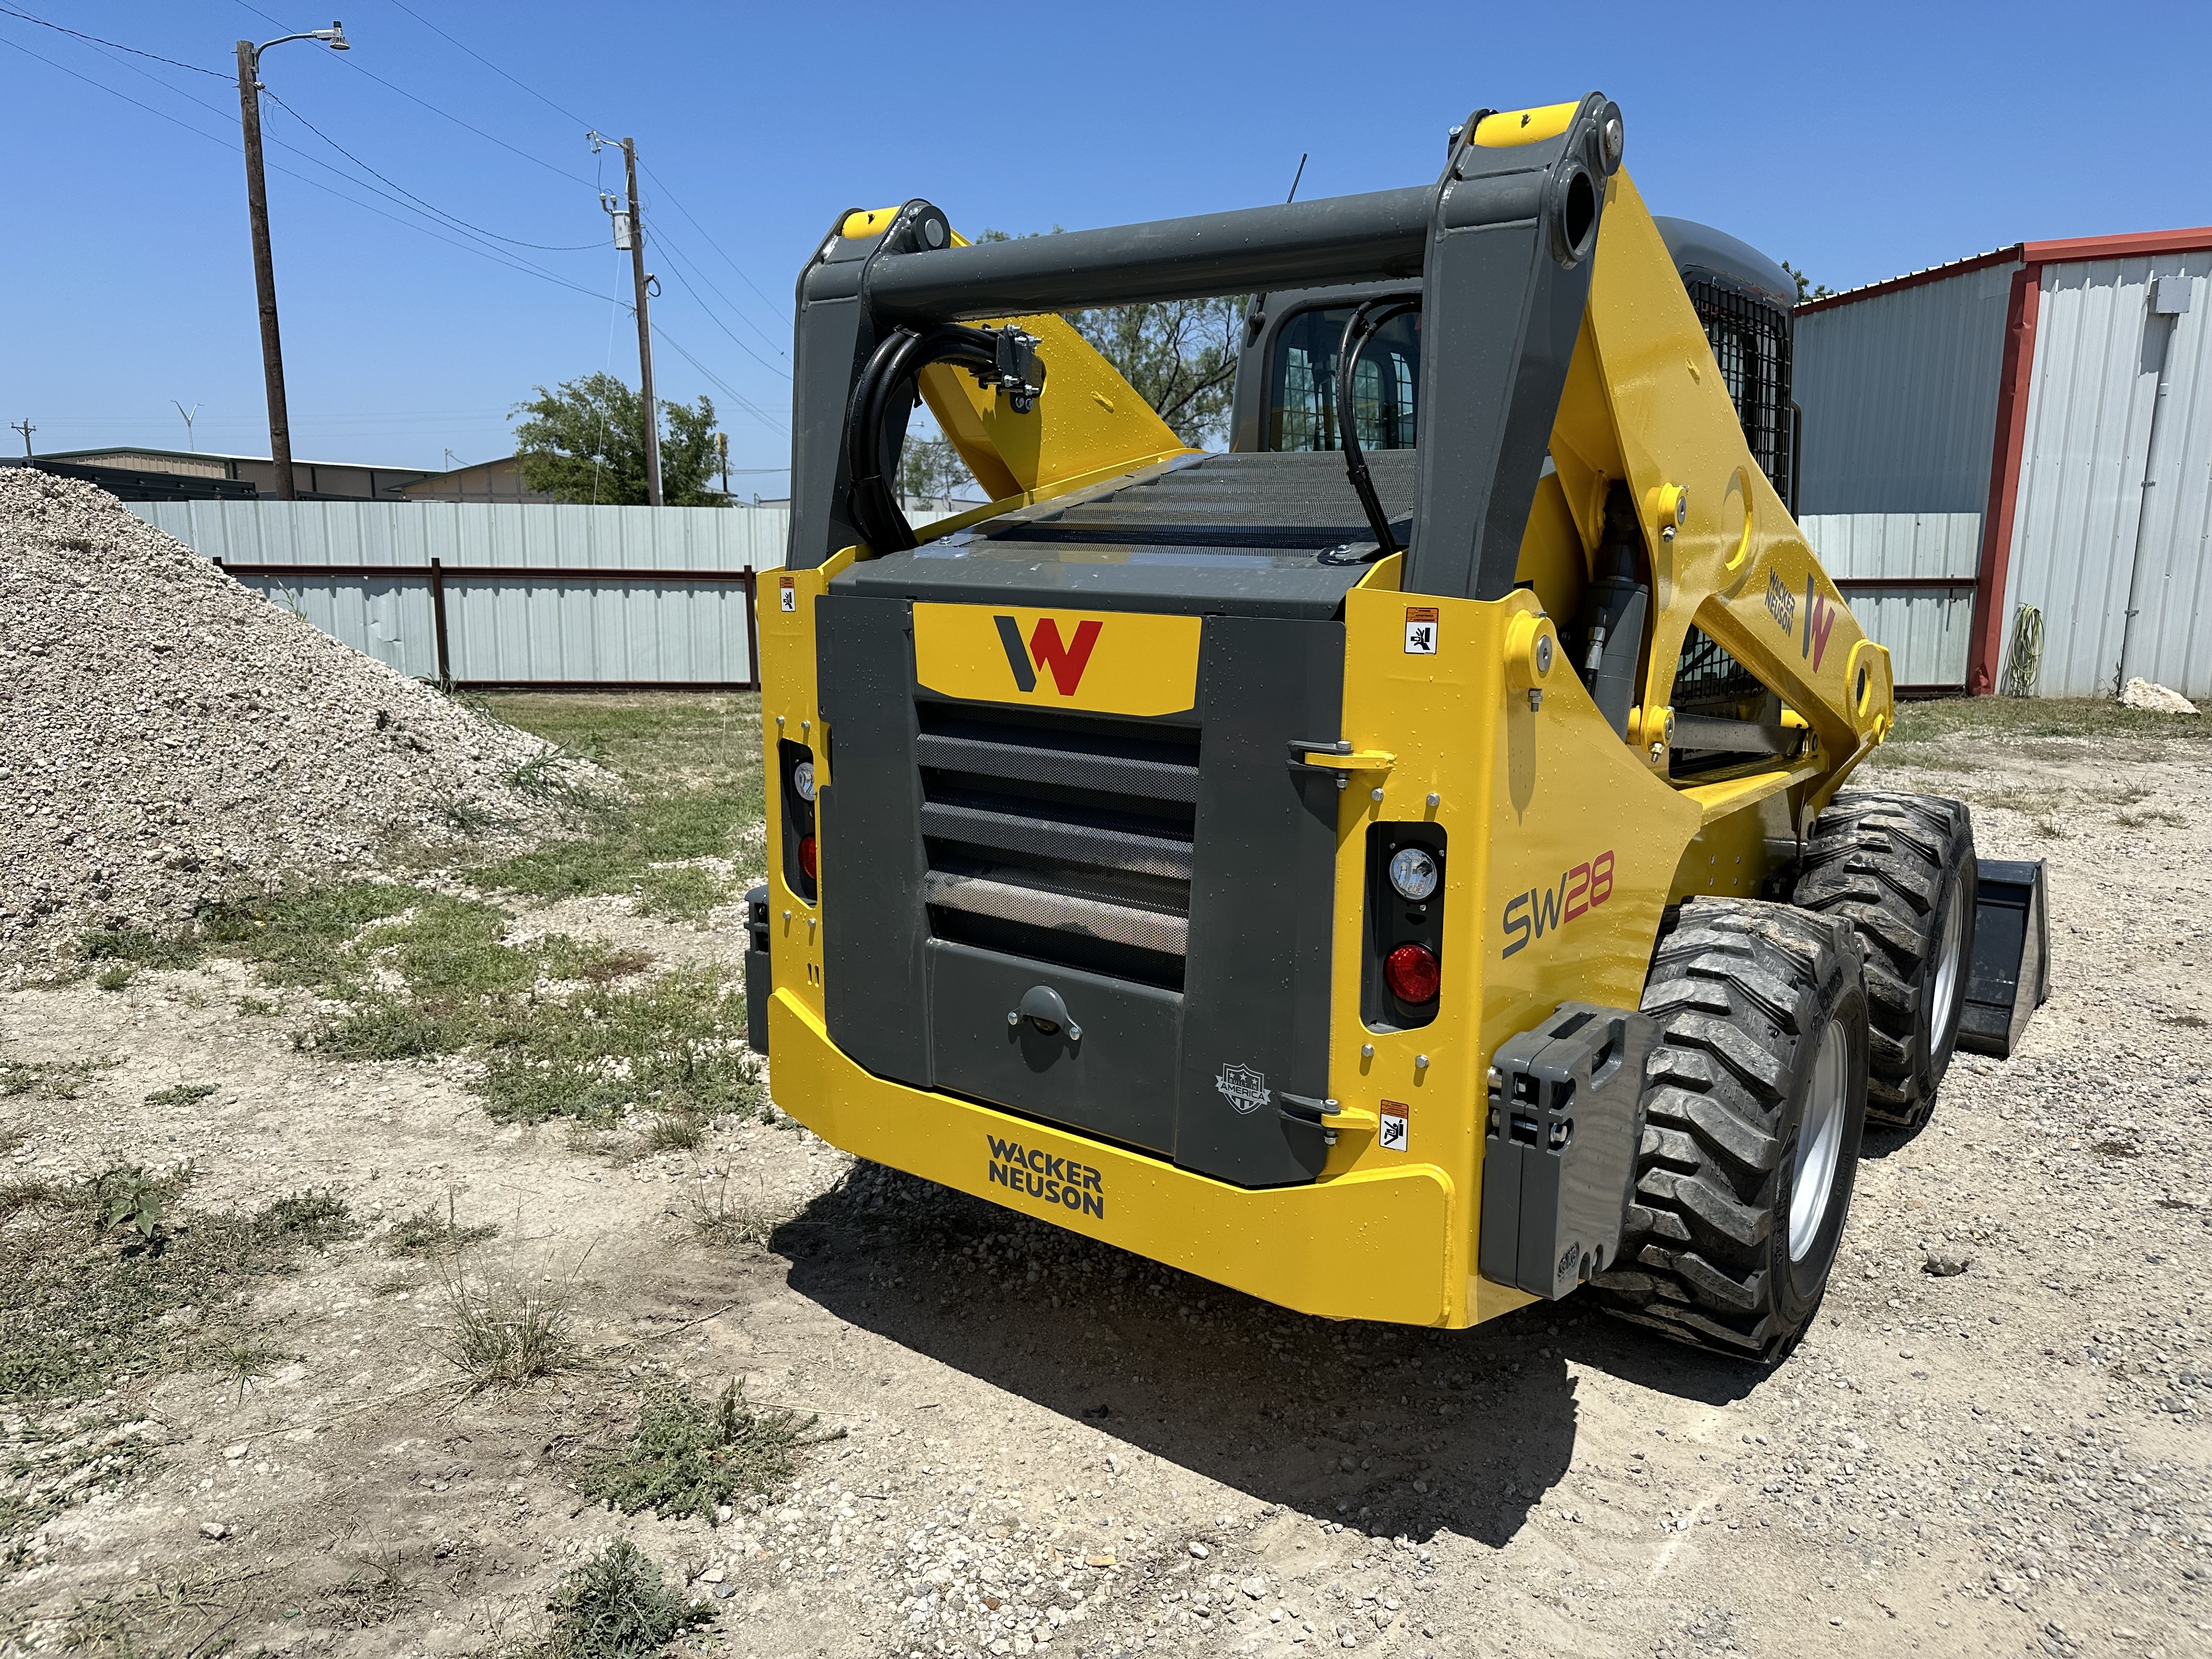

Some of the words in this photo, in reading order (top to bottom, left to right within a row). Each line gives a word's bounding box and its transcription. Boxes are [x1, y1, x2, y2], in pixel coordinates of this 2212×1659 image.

[1764, 586, 1793, 638] NEUSON
[1769, 566, 1795, 619] WACKER
[1502, 849, 1615, 960] SW28
[1220, 1082, 1265, 1101] AMERICA
[1228, 1078, 1248, 1087] BUILT
[986, 1134, 1104, 1194] WACKER
[989, 1159, 1104, 1220] NEUSON
